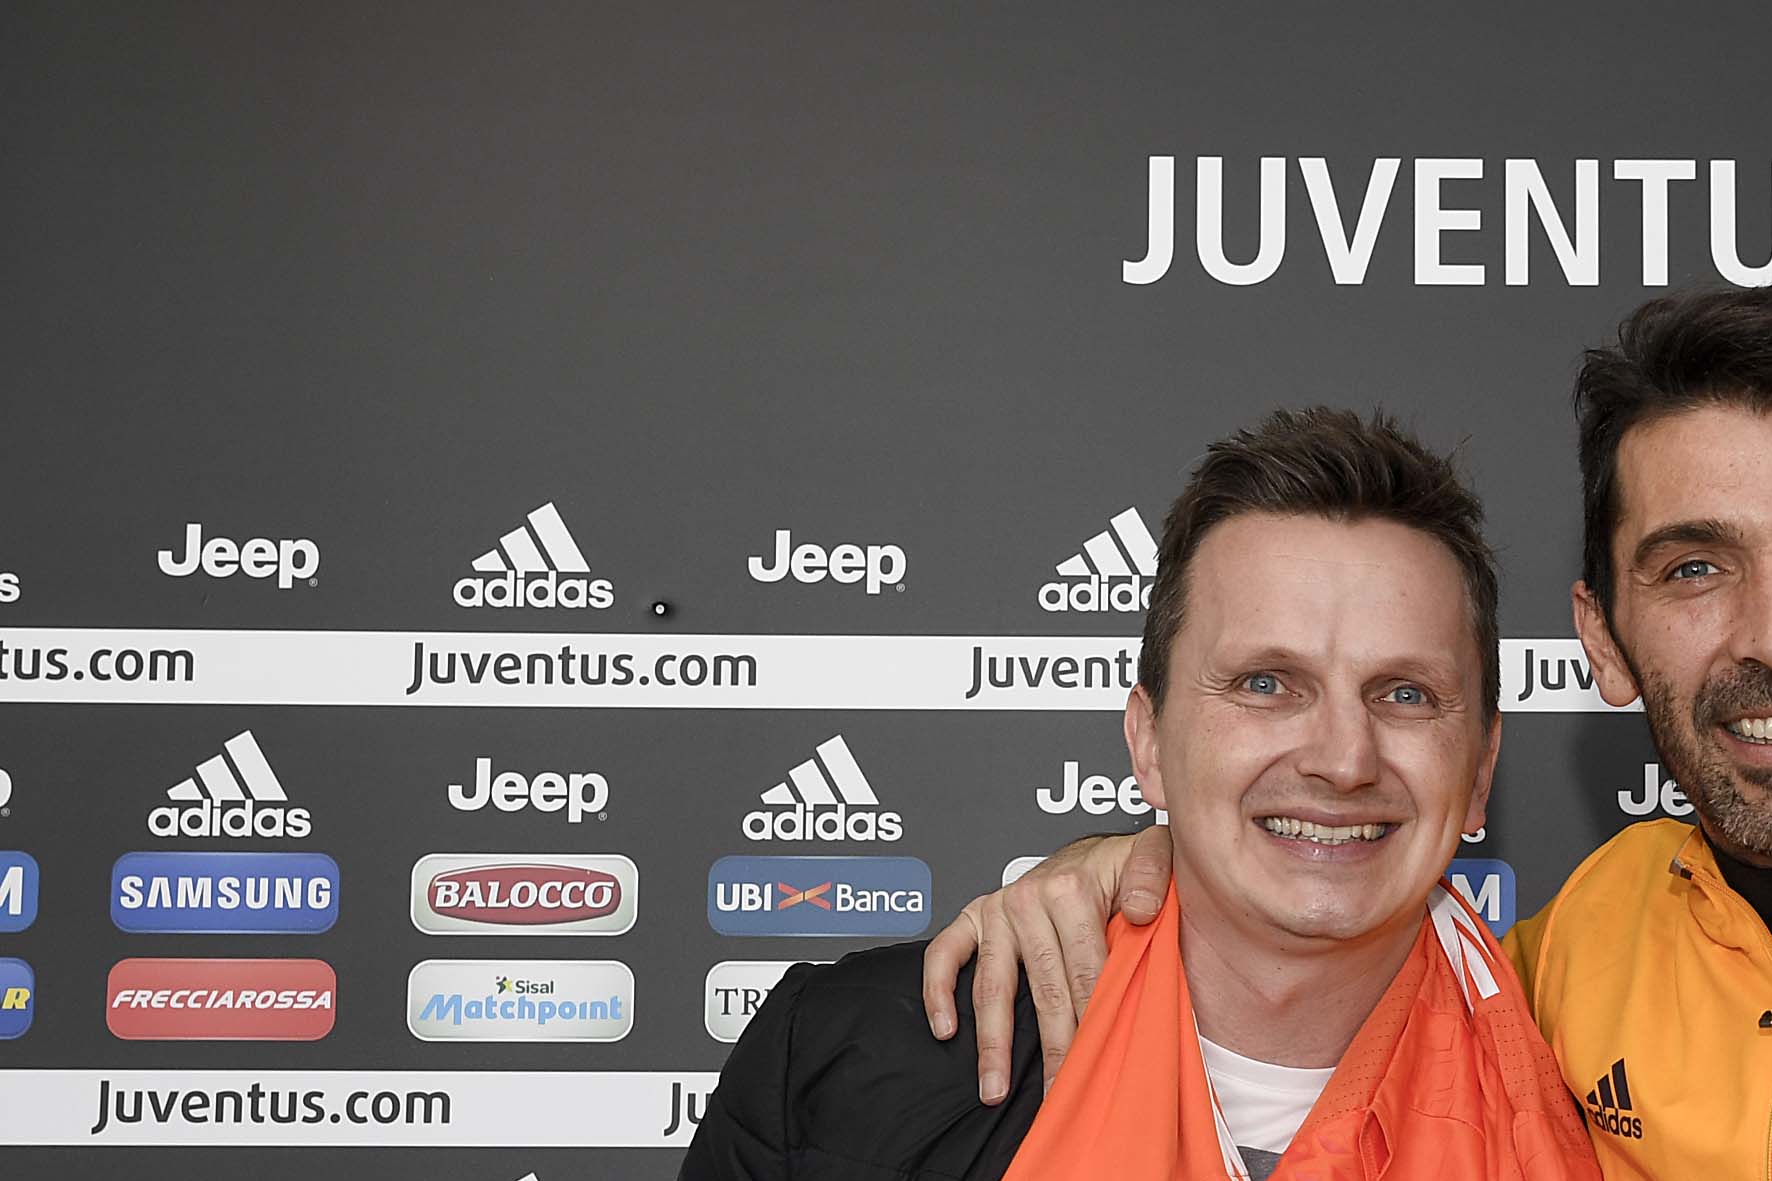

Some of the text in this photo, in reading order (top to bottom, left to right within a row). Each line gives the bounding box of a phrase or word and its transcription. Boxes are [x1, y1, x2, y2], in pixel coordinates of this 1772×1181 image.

[158, 523, 320, 589] Jeep
[748, 529, 907, 594] Jeep
[453, 570, 615, 610] adidas
[1038, 573, 1154, 613] adid
[406, 642, 758, 696] Juventus.com
[966, 646, 1133, 699] Juvent
[448, 757, 609, 822] Jeep
[1036, 761, 1168, 825] Jee
[147, 798, 312, 838] adidas
[742, 801, 903, 842] adidas
[120, 875, 332, 910] SAMSUNG
[434, 880, 615, 909] BALOCCO
[714, 883, 924, 913] UBI Banca
[111, 989, 332, 1010] FRECCIAROSSA
[515, 979, 554, 994] Sisal
[419, 993, 623, 1026] Matchpoint
[90, 1080, 451, 1135] Juventus.com
